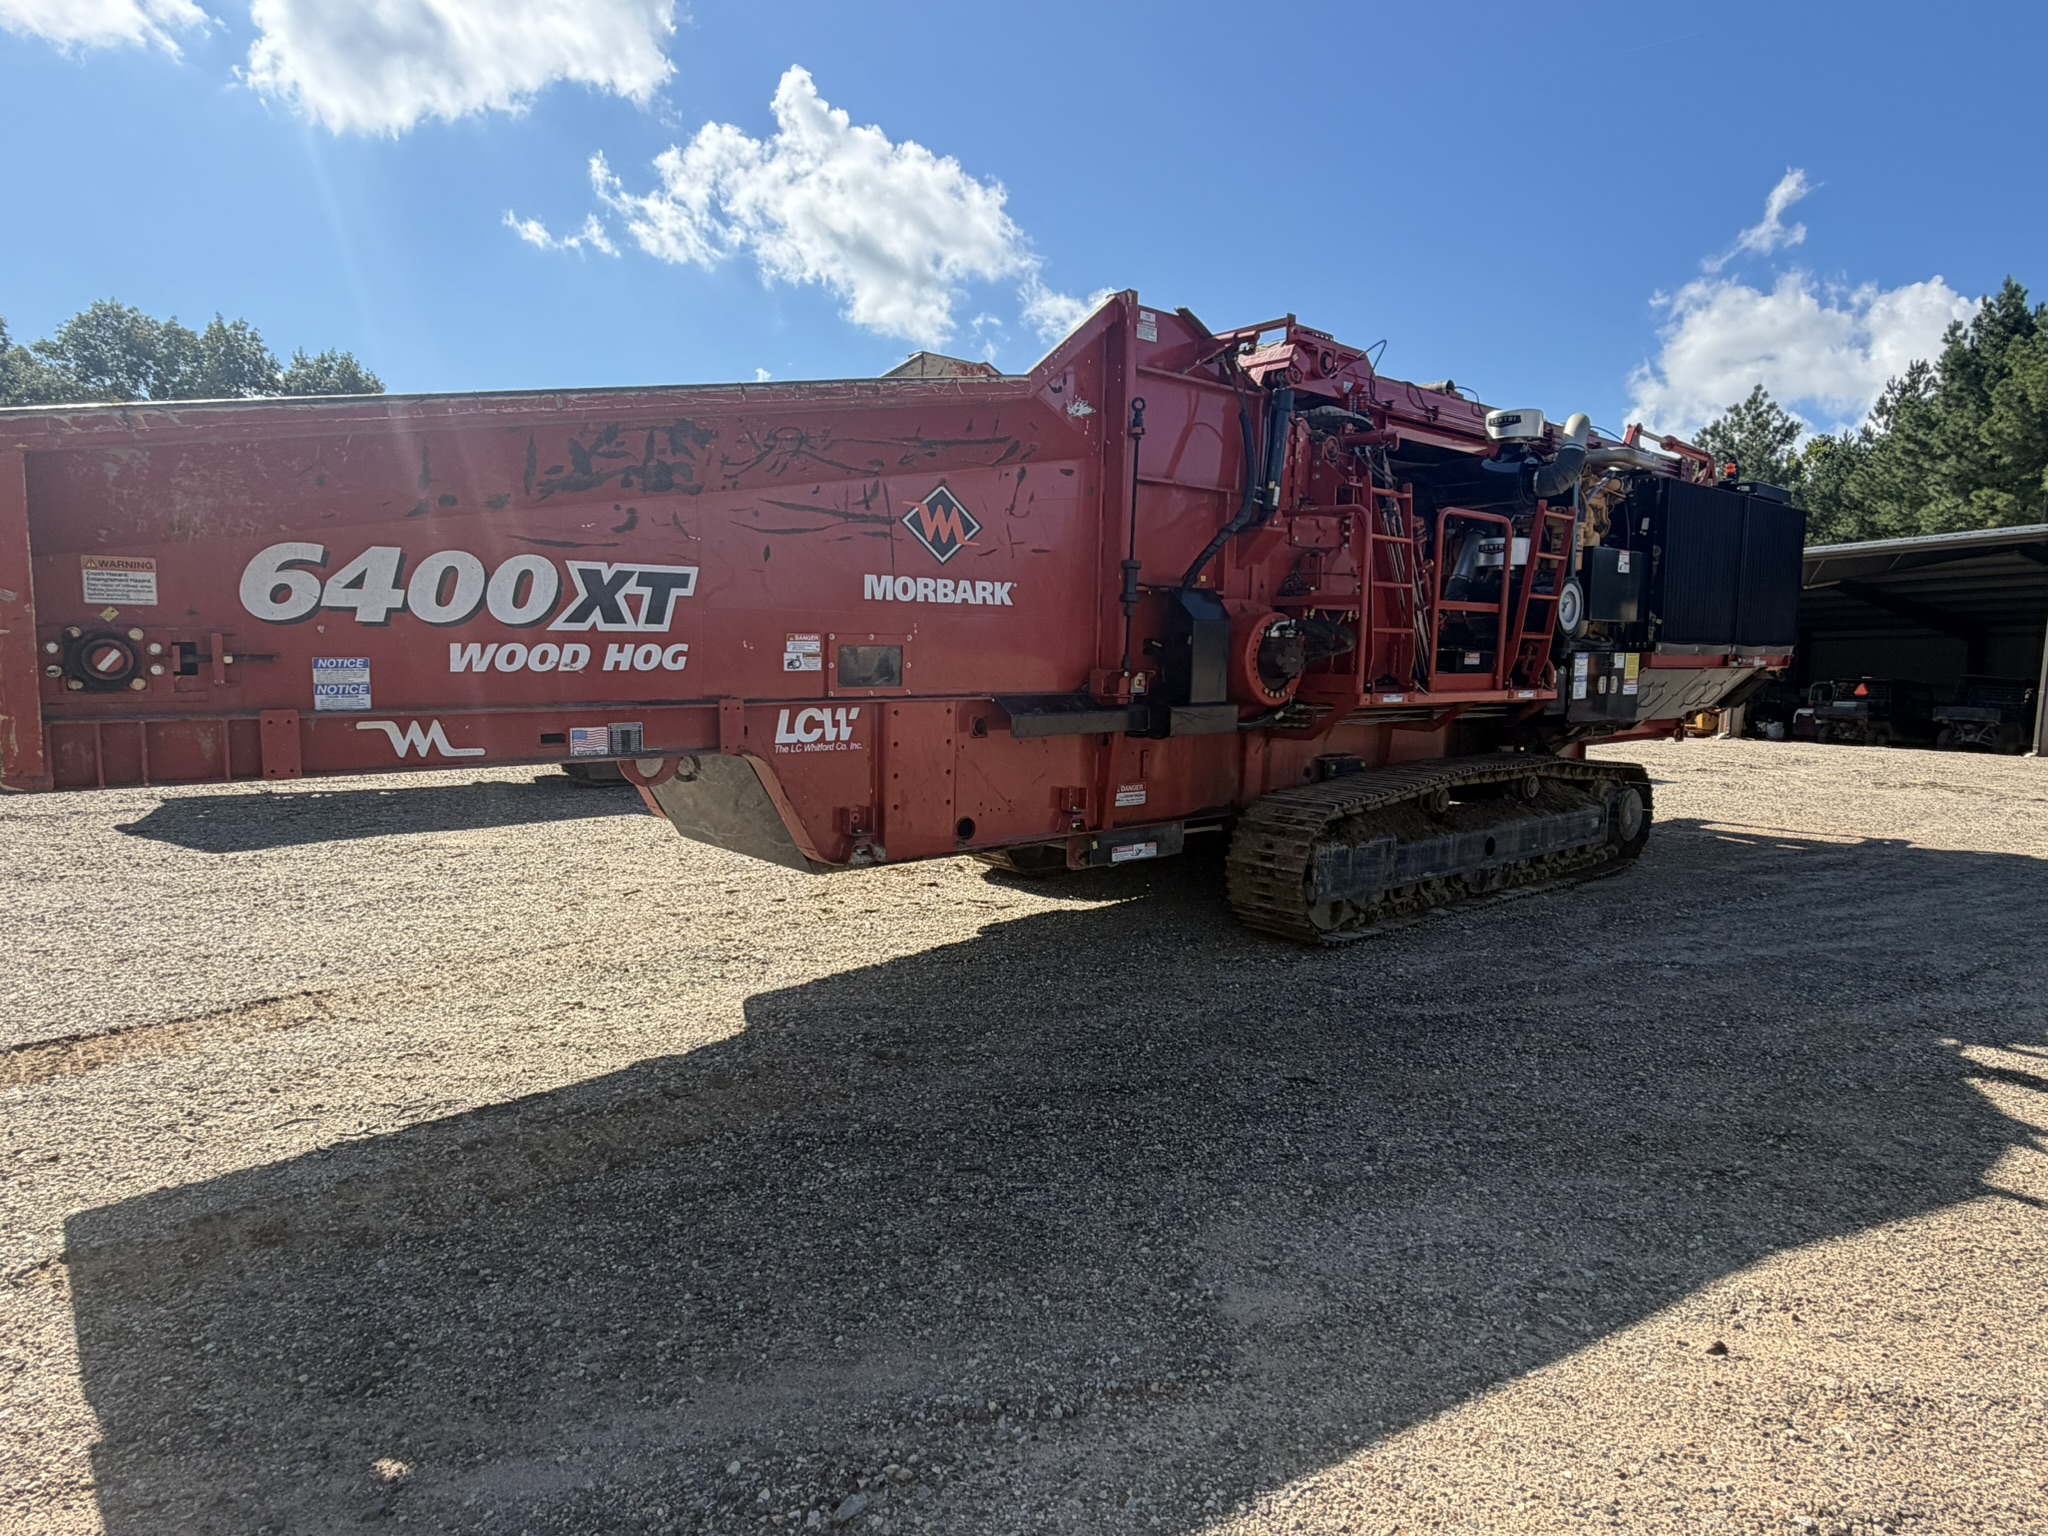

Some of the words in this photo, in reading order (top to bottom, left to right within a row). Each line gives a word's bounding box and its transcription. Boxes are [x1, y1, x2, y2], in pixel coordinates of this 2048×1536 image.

[97, 559, 153, 569] WARNING
[864, 574, 1013, 606] MORBARK
[317, 658, 365, 668] NOTICE
[449, 642, 590, 673] WOOD
[602, 643, 689, 672] HOG
[316, 684, 369, 695] NOTICE
[775, 707, 860, 744] LCW
[775, 745, 790, 754] The
[790, 744, 802, 753] LC
[804, 743, 835, 752] Whitford
[836, 742, 848, 751] Co.
[849, 741, 863, 750] Inc.
[1120, 784, 1144, 792] DANGER
